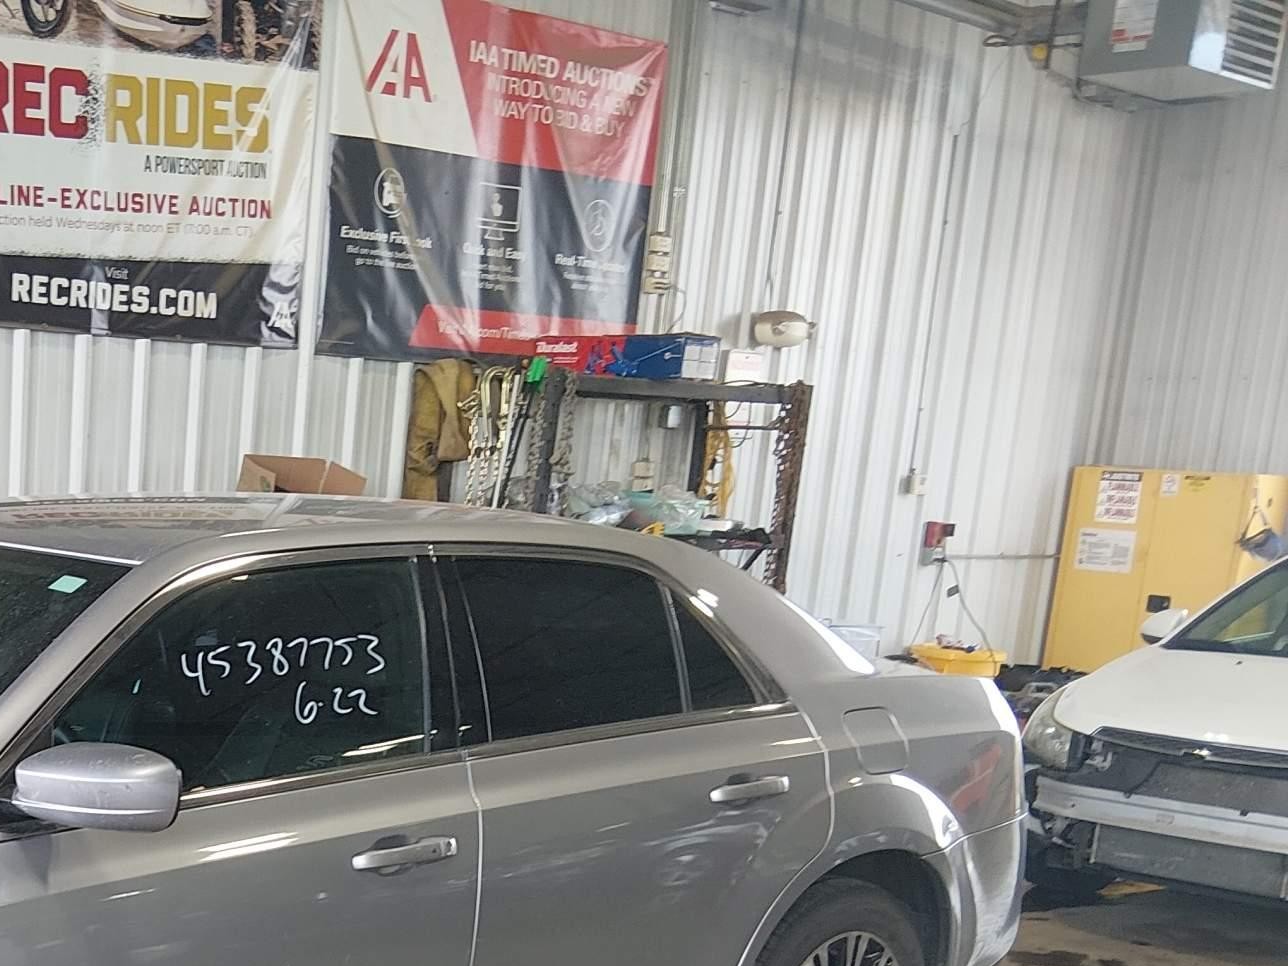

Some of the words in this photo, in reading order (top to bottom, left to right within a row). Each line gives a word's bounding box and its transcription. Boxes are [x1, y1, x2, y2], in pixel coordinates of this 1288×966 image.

[469, 40, 499, 67] IAA
[501, 48, 560, 78] TIMED
[563, 61, 648, 97] AUCTIONS
[487, 72, 587, 108] INTRODUCING
[494, 99, 529, 120] WAY
[530, 104, 554, 124] TO
[556, 109, 579, 129] BID
[580, 113, 593, 132] &
[595, 116, 626, 137] BUY
[144, 154, 153, 173] A
[155, 156, 225, 175] POWERSPORT
[226, 160, 267, 179] AUCTION
[27, 215, 53, 227] held
[136, 224, 164, 233] noon
[167, 222, 181, 234] ET
[188, 195, 273, 219] AUCTION
[105, 266, 129, 280] Visit
[11, 273, 218, 319] RECRIDES.COM
[181, 634, 386, 696] 45387753
